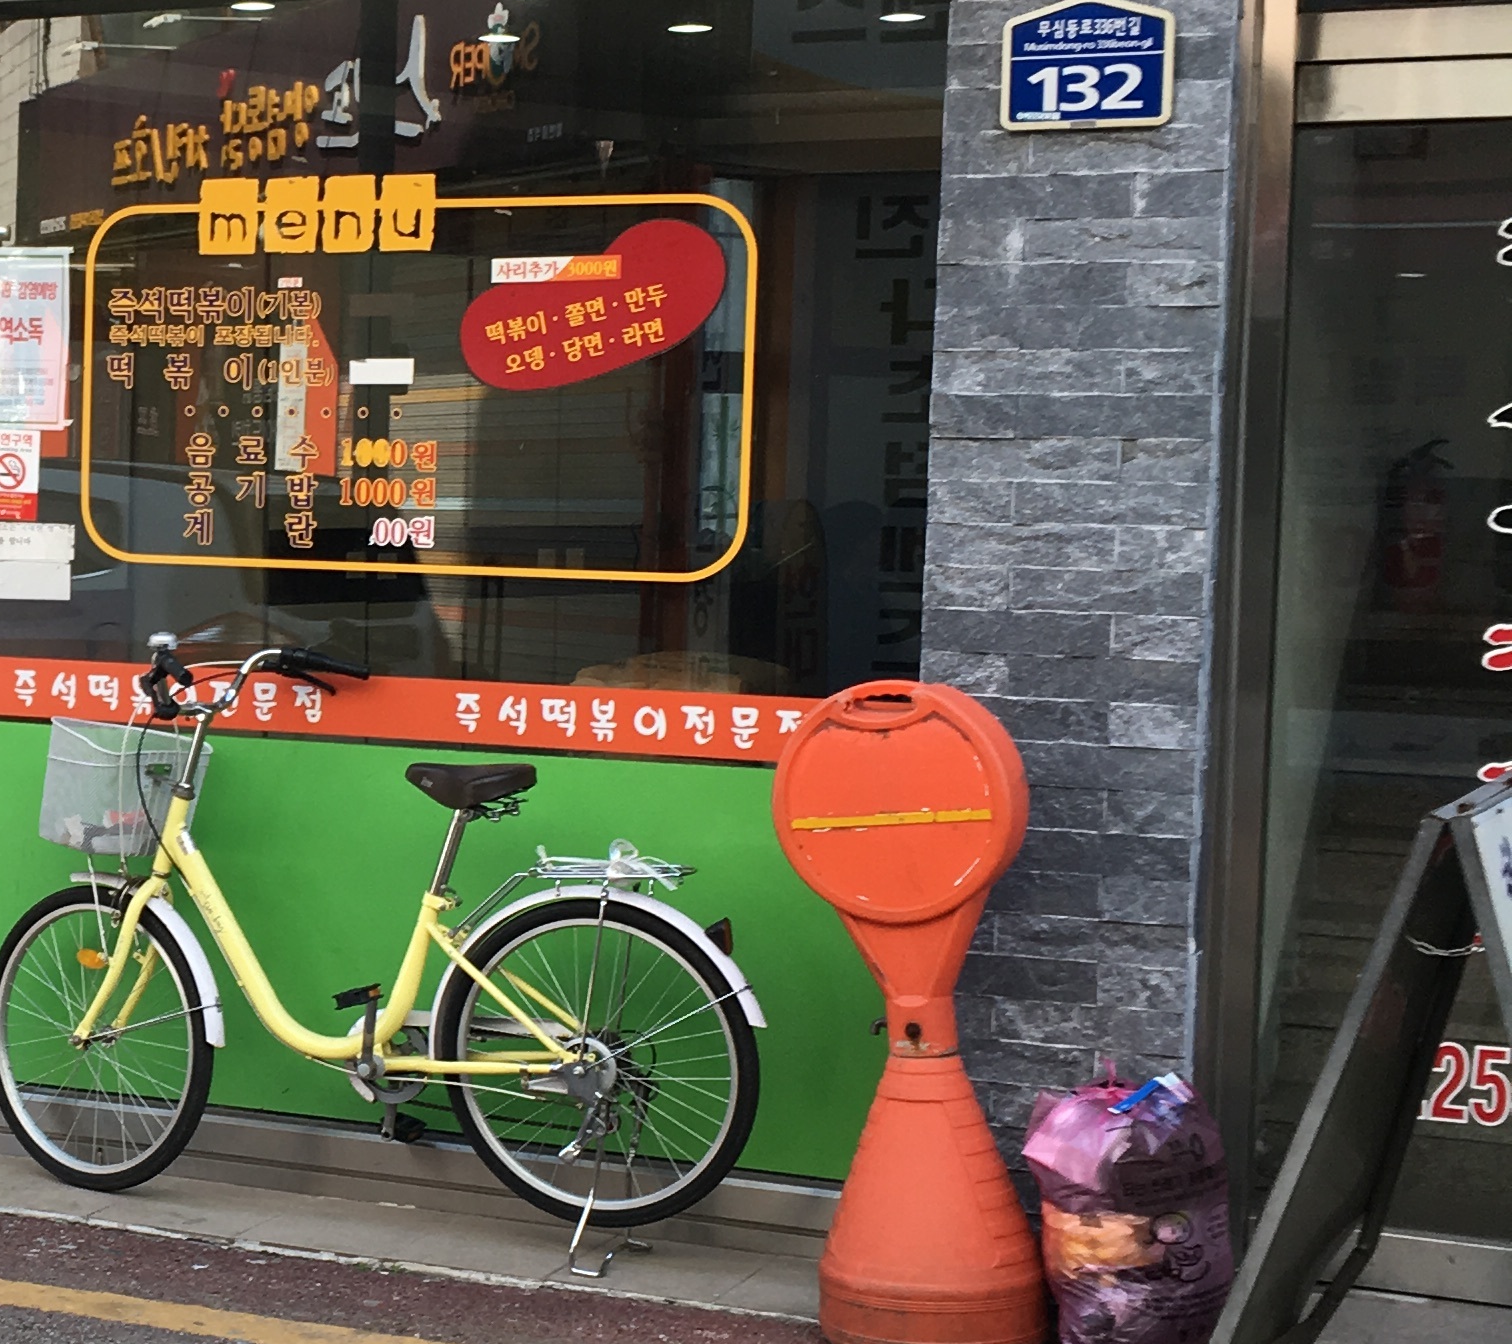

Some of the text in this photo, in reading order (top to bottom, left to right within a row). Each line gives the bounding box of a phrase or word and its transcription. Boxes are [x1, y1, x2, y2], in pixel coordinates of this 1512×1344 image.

[1026, 62, 1145, 113] 132
[207, 206, 422, 244] menu
[495, 260, 560, 280] 사리추가
[108, 286, 322, 324] 즉석떡볶이(기본)
[485, 283, 669, 346] 떡볶이 쫄면 만두
[108, 324, 321, 348] 즉석떡볶이 포장됩니다.
[562, 331, 605, 362] 당면
[621, 317, 666, 348] 라면
[340, 438, 438, 473] 10원
[339, 476, 438, 510] 1000원
[368, 516, 436, 549] 00원
